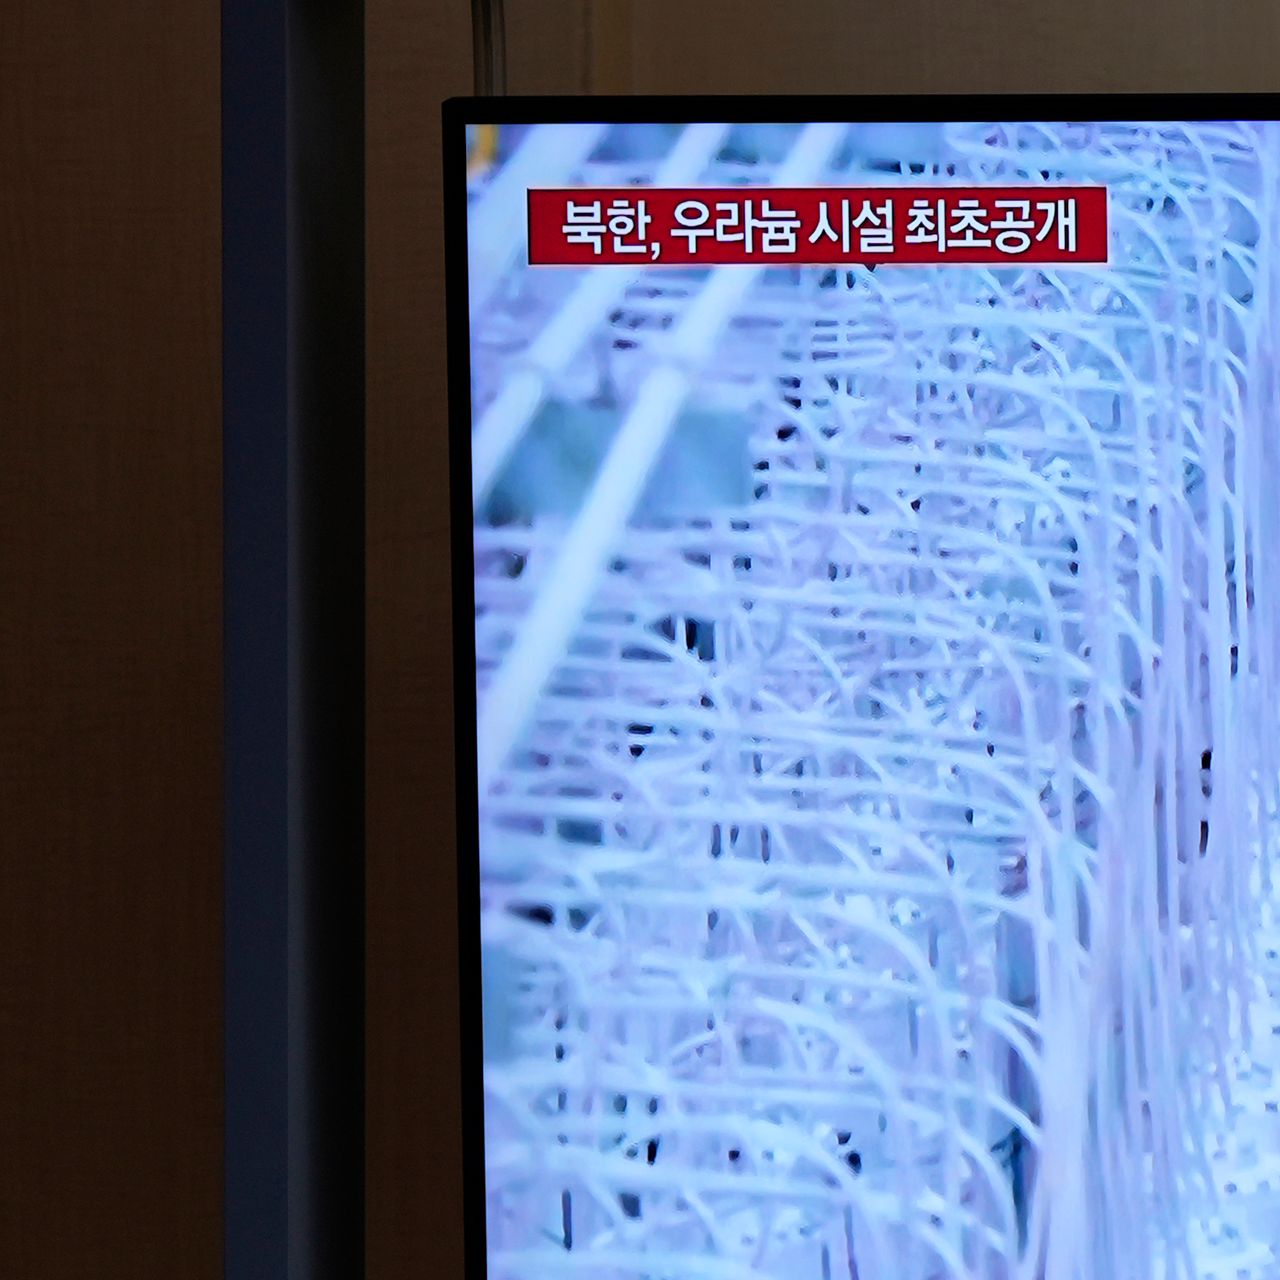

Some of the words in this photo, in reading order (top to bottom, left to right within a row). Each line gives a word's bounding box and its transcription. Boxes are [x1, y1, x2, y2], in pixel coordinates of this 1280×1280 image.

[562, 200, 662, 260] 북한,
[672, 200, 802, 255] 우라늄
[809, 200, 895, 254] 시설
[906, 199, 1077, 255] 최초공개
